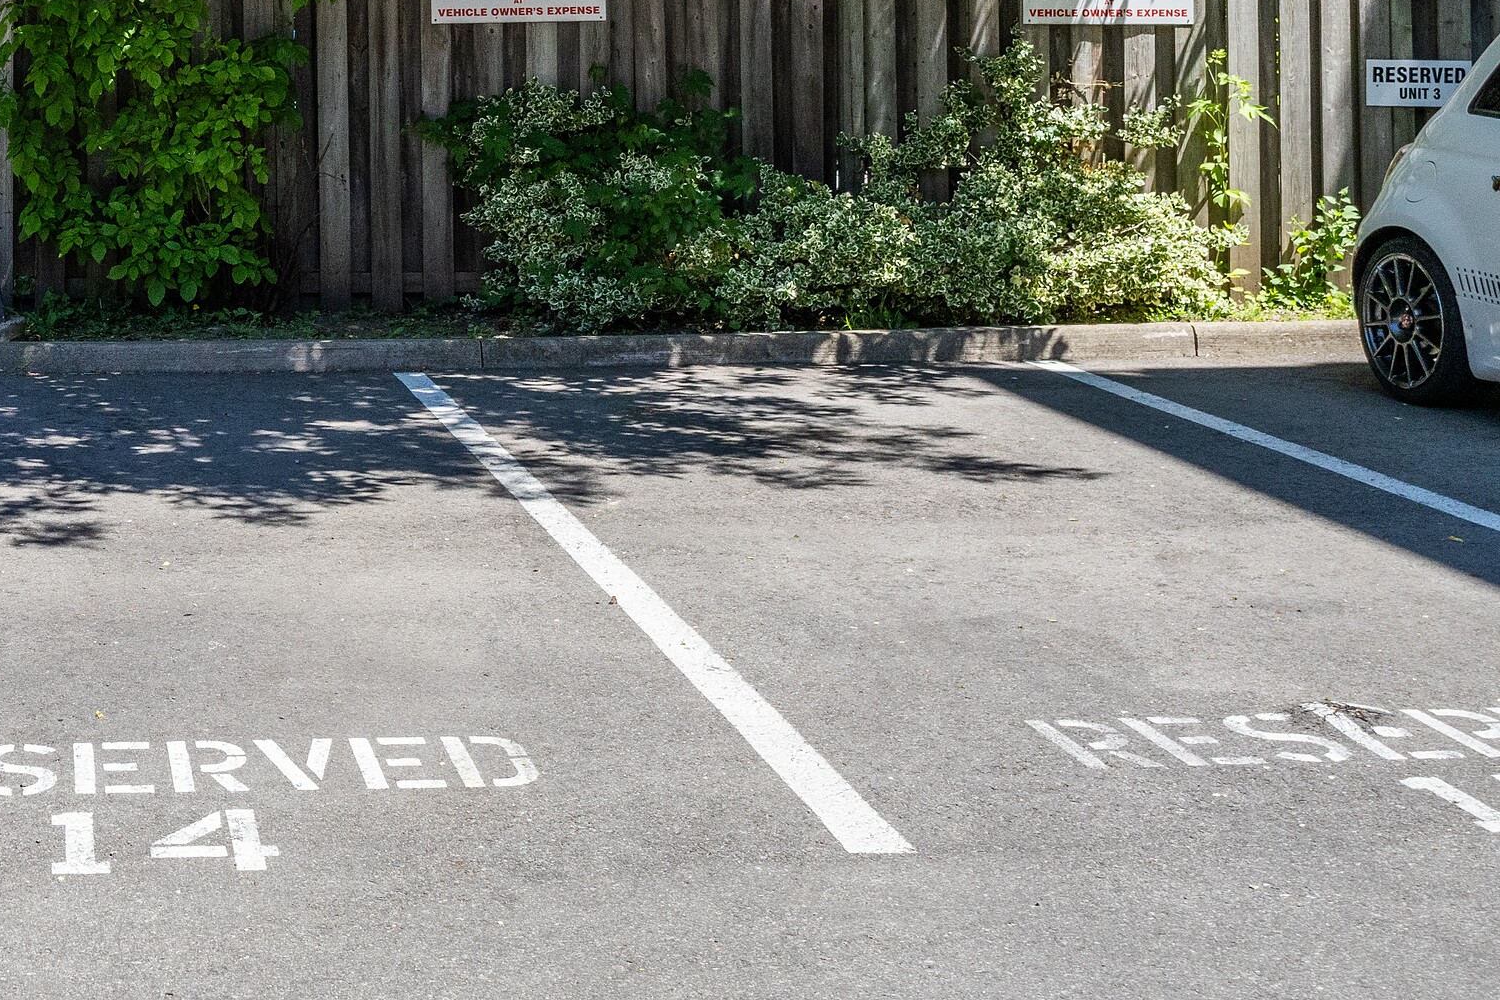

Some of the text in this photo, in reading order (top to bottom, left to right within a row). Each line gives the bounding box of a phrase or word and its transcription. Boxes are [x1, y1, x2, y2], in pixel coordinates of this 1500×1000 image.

[438, 6, 600, 17] VEHICLE OWNER'S EXPENSE
[1029, 8, 1188, 18] VEHICLE OWNER'S EXPENSE
[1372, 66, 1466, 84] RESERVED
[1399, 87, 1441, 100] UNIT 3
[1025, 699, 1500, 769] RESER
[50, 808, 281, 876] 14
